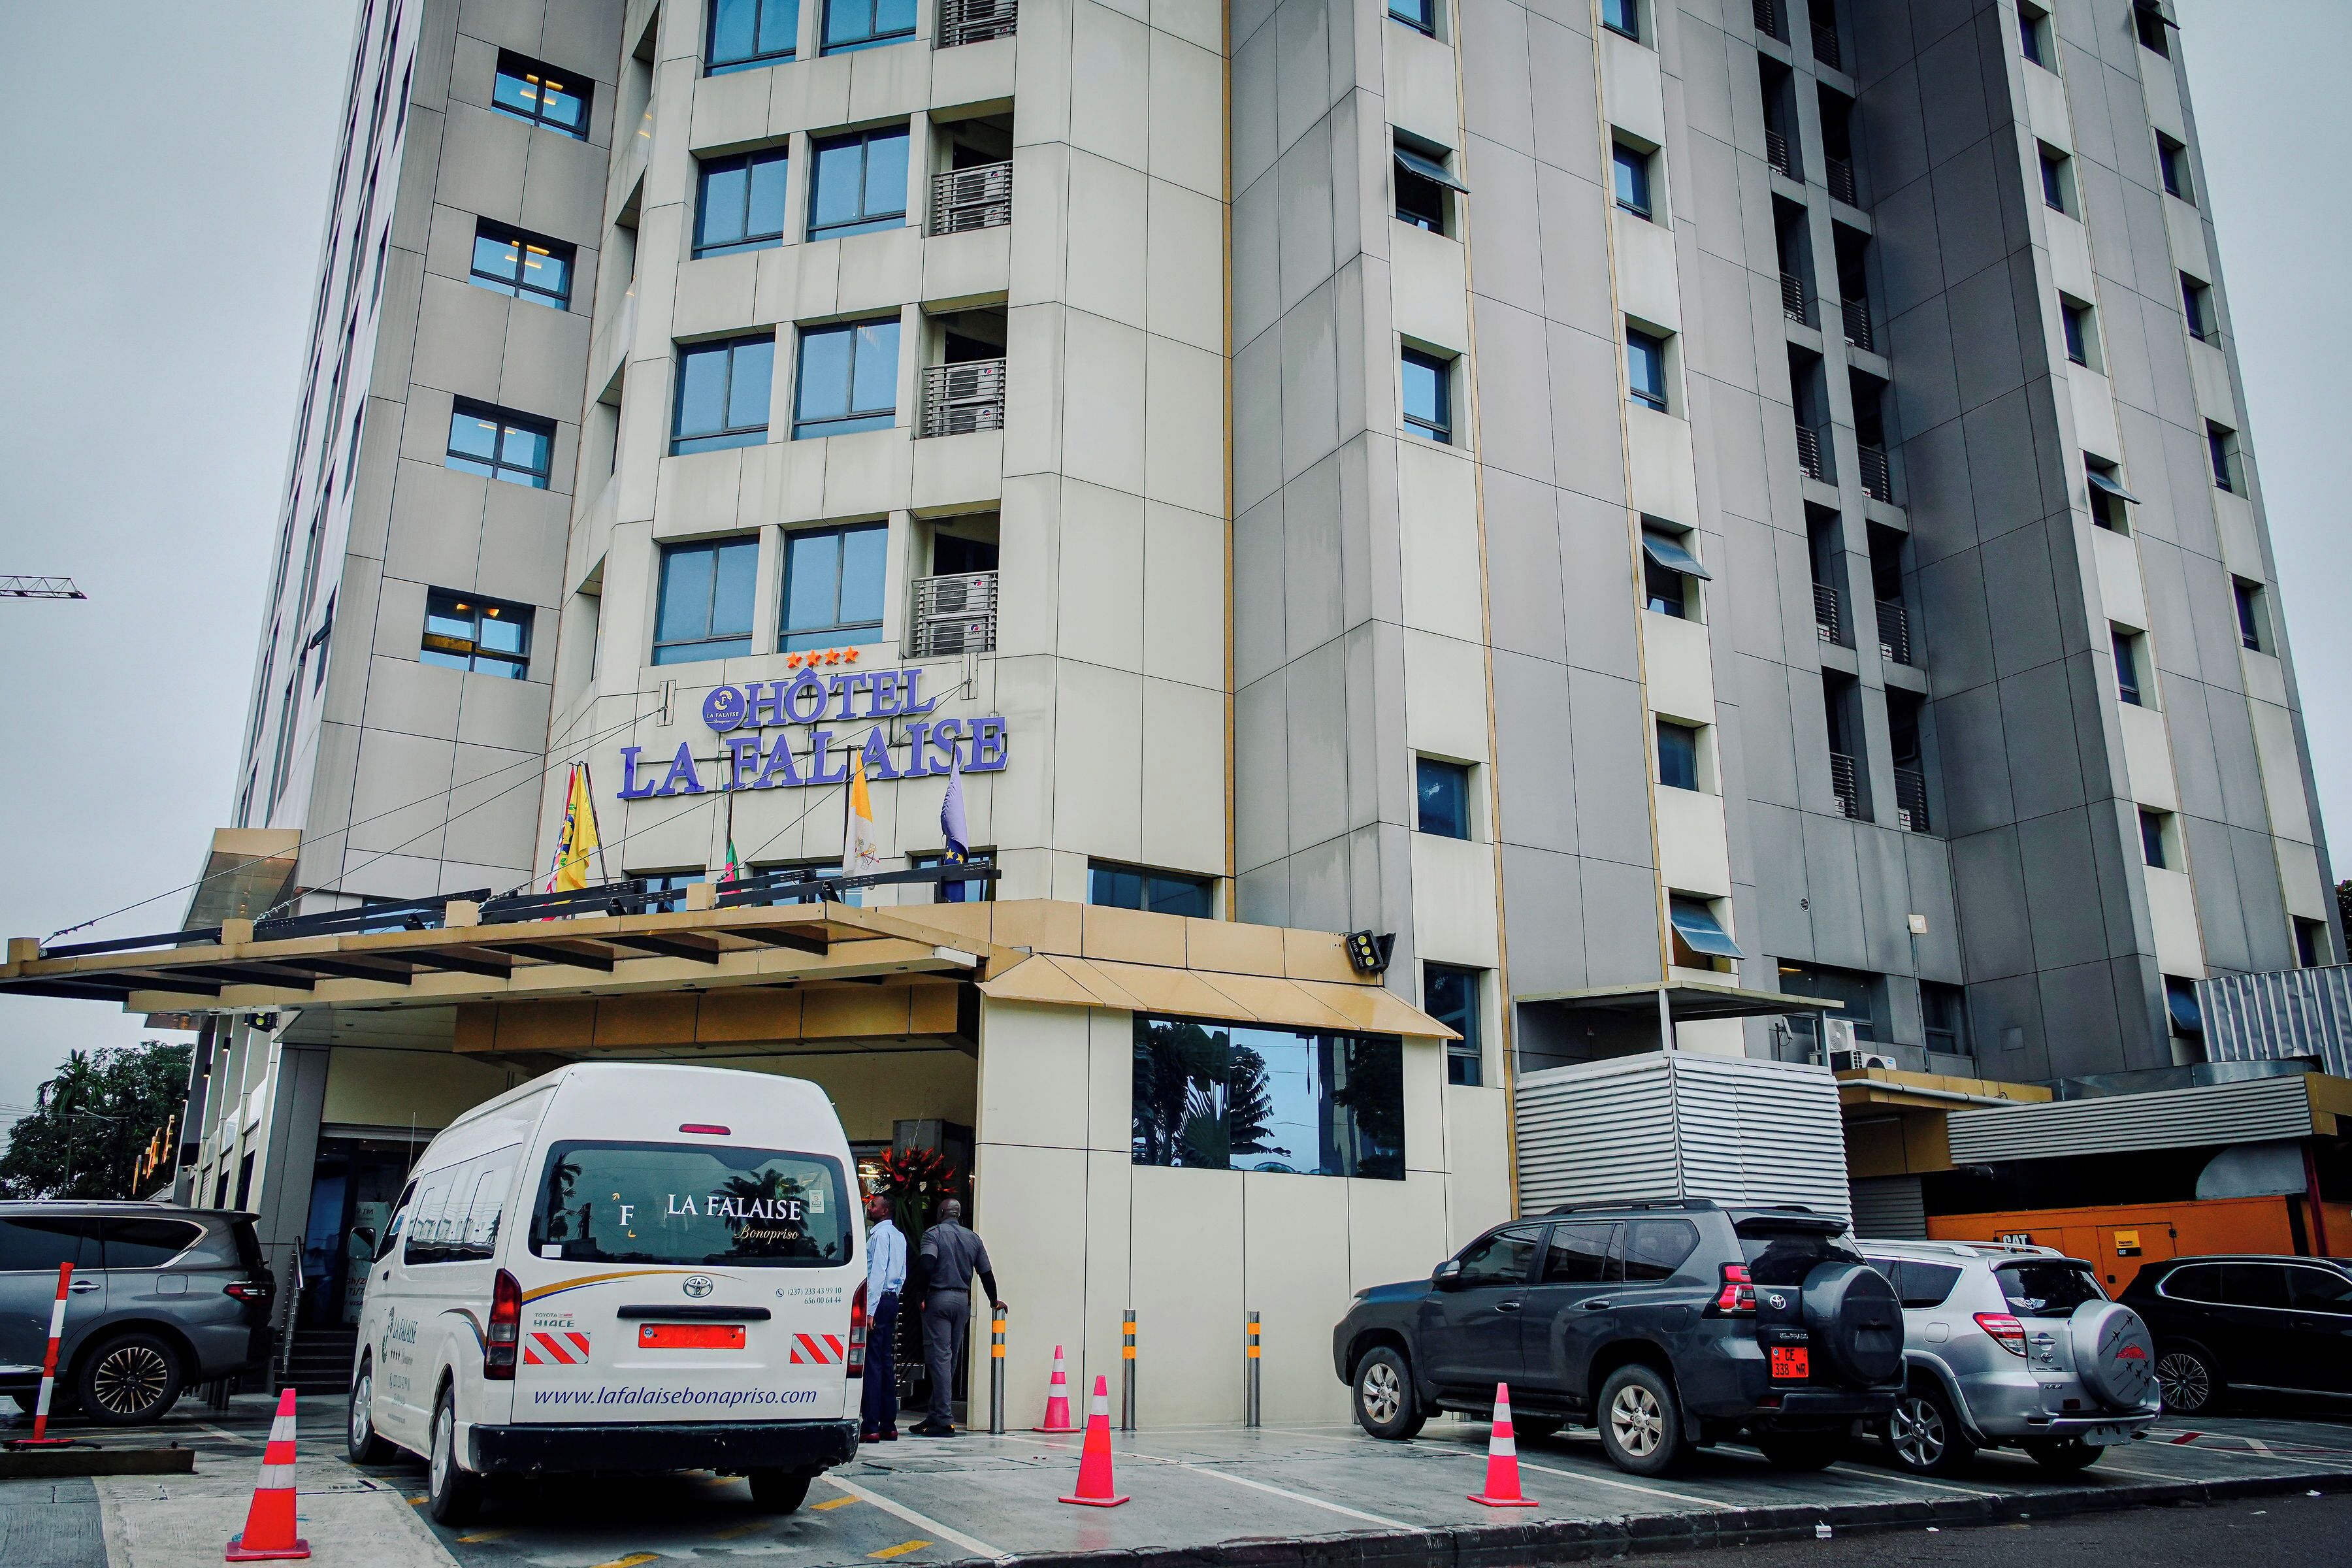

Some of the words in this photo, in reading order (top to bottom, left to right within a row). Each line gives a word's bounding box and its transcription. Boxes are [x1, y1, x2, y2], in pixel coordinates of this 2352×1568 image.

[743, 668, 936, 729] HÔTEL
[617, 742, 706, 800] LA
[725, 717, 1009, 791] FALAISE
[619, 1205, 634, 1226] F
[667, 1194, 699, 1216] LA
[706, 1196, 802, 1221] FALAISE
[734, 1224, 800, 1245] Bonapriso
[2002, 1234, 2027, 1245] CAT
[787, 1288, 804, 1296] (237)
[1785, 1348, 1795, 1362] CE
[1774, 1363, 1789, 1375] 338
[1795, 1363, 1806, 1375] NR
[534, 1386, 817, 1408] www.lafalaisebonapriso.com
